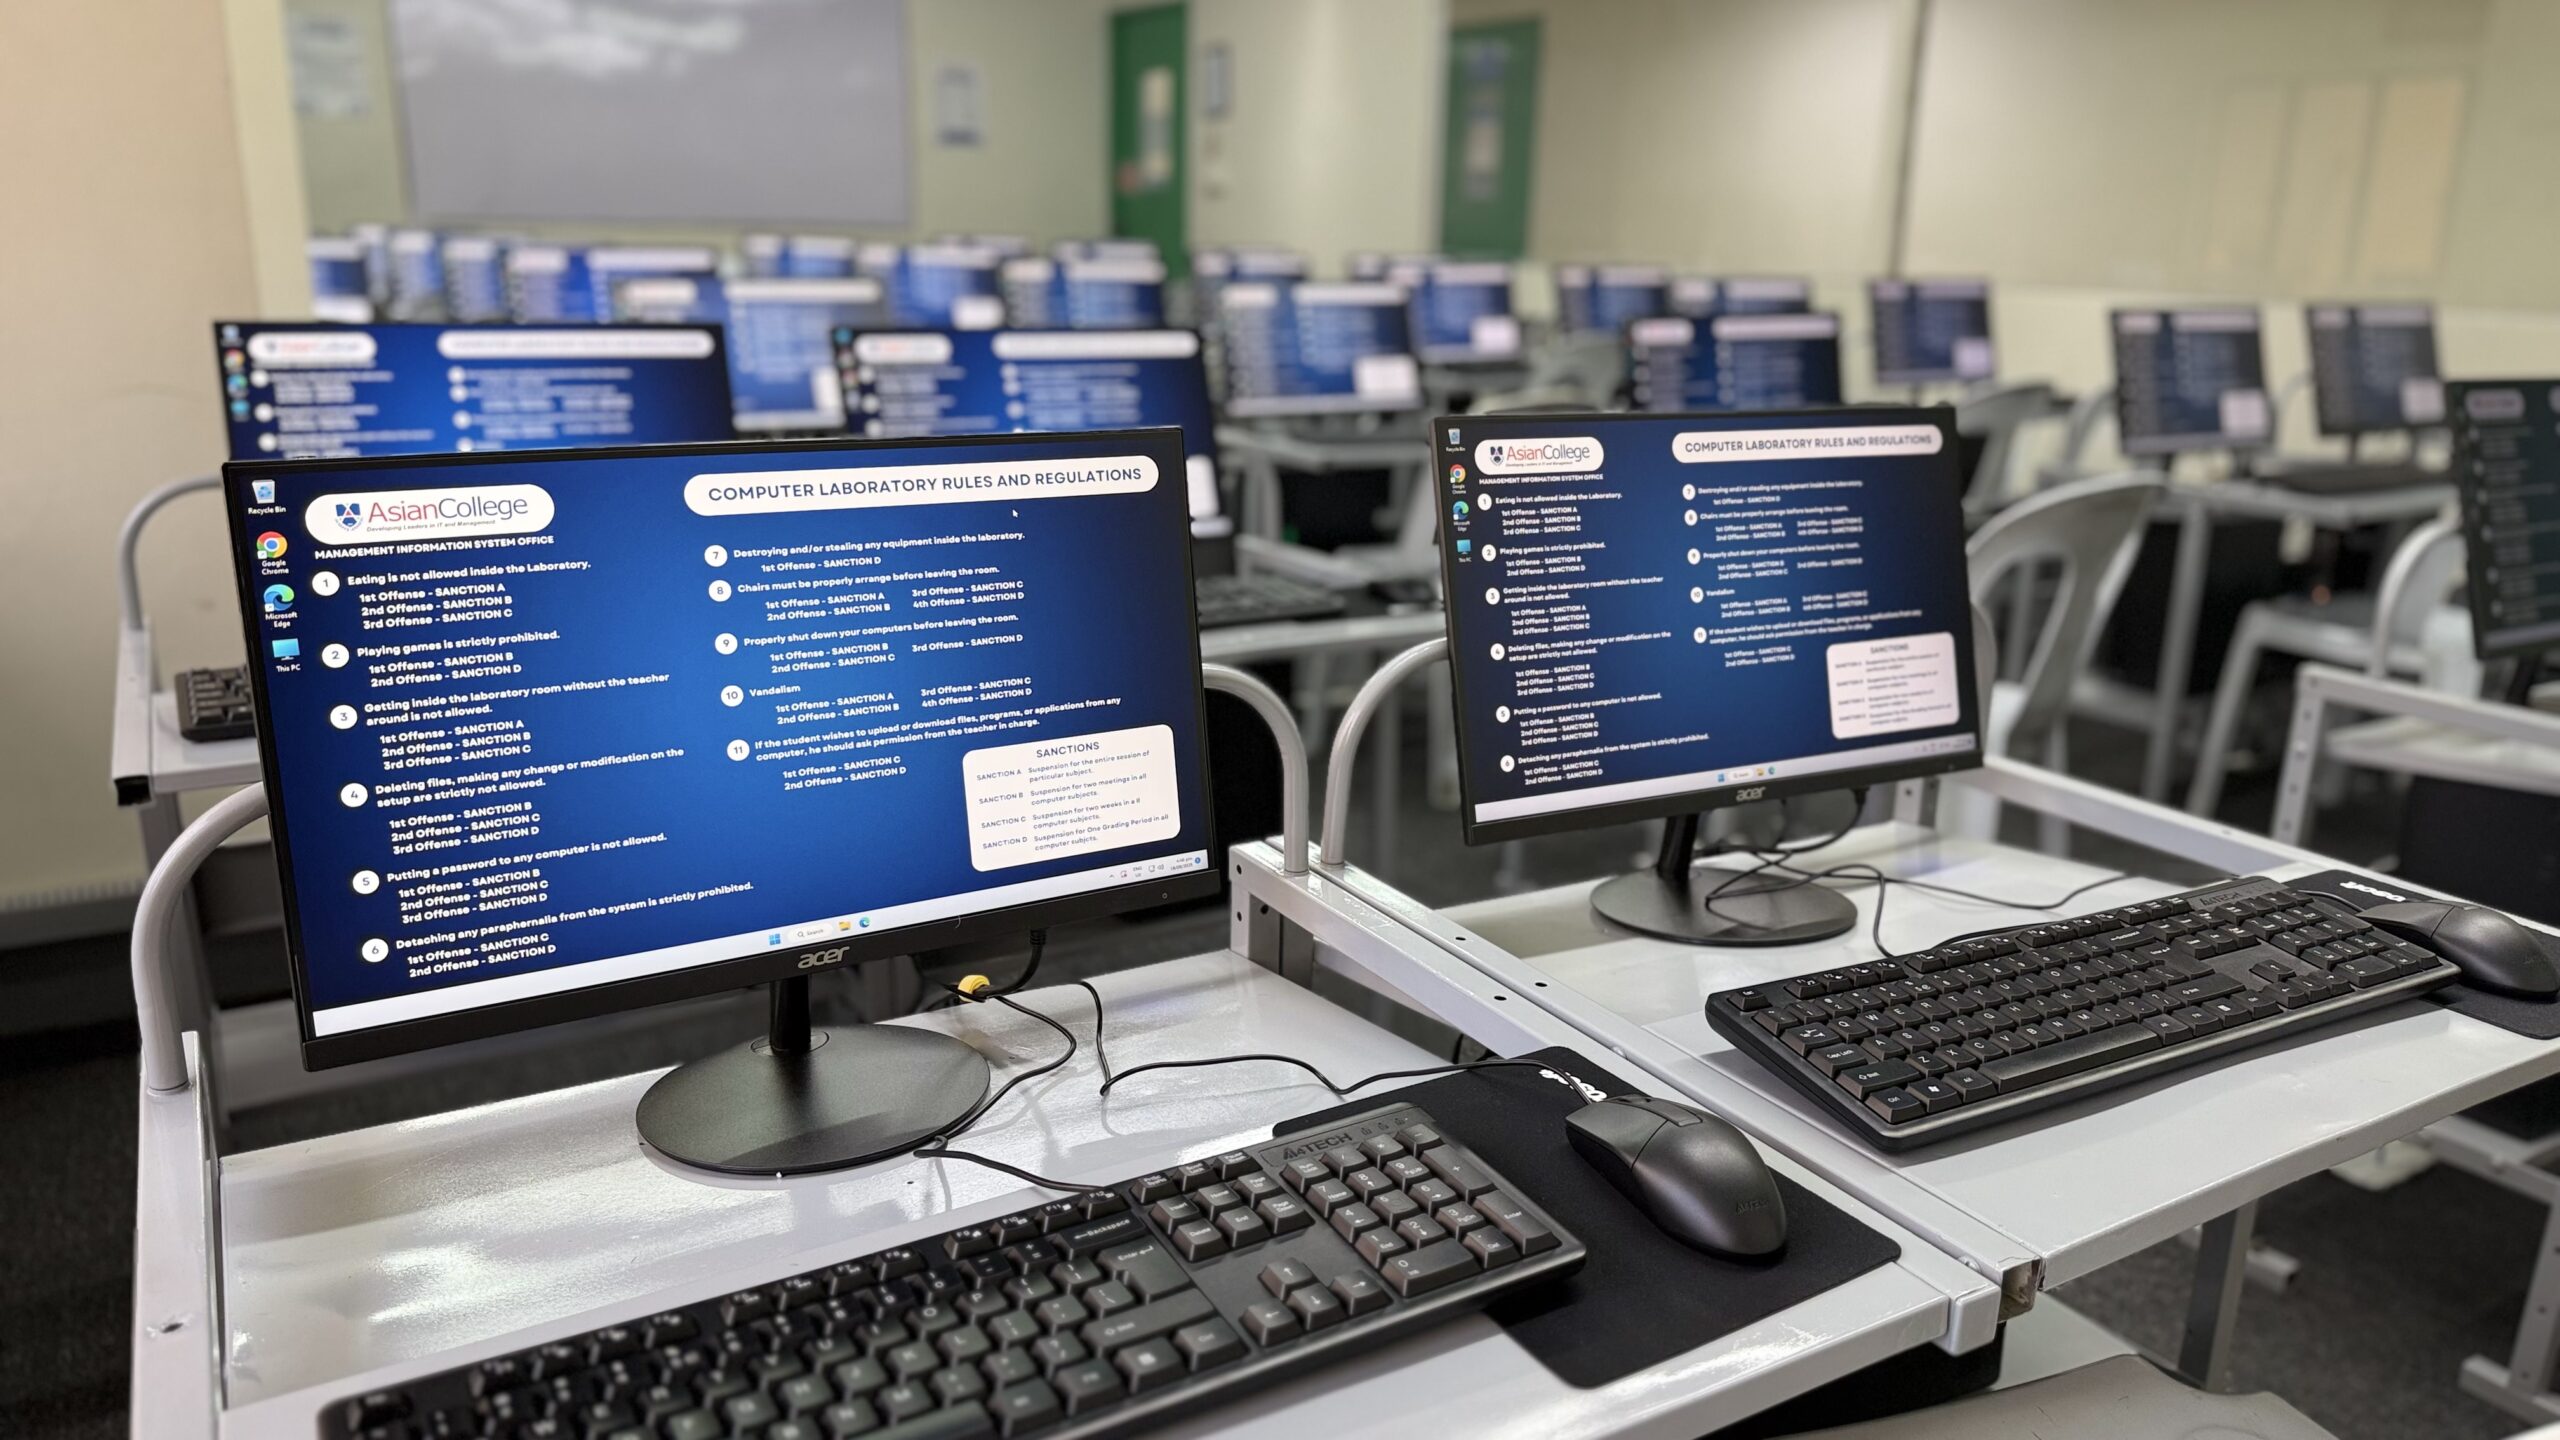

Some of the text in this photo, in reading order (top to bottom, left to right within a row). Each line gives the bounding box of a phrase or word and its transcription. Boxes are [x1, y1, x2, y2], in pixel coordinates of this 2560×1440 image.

[1685, 434, 1931, 452] COMPUTER LABORATORY RULES AND REGULATIONS
[1507, 444, 1590, 462] AsianCollege
[708, 468, 1141, 500] COMPUTER LABORATORY RULES AND REGULATIONS
[248, 507, 274, 515] Recycle
[368, 496, 528, 523] AsianCollege
[314, 535, 554, 559] MANAGEMENT INFORMATION SYSTEM OFFICE
[713, 532, 1025, 559] 7 Destroying and/or stealing any equipment inside the laboratory.
[261, 560, 286, 568] Google
[323, 561, 591, 587] 1 Eating is not allowed inside the Laboratory.
[717, 566, 999, 595] 8 Chairs must be properly arrange before leaving the room.
[359, 593, 376, 602] 1st
[378, 590, 425, 601] Offense
[434, 583, 494, 596] SANCTION
[496, 583, 505, 591] A
[265, 611, 297, 620] Microsoft
[273, 620, 291, 629] Edge
[332, 630, 560, 660] 2 Playing games is strictly prohibited.
[276, 664, 290, 672] This
[340, 674, 669, 721] 3 Getting inside the laboratory room without the teacher
[727, 684, 800, 699] 10 Vandalism
[366, 703, 492, 725] around is not allowed.
[1036, 741, 1099, 758] SANCTIONS
[375, 780, 425, 794] Deleting
[426, 777, 455, 787] files,
[456, 771, 499, 783] making
[501, 769, 521, 778] any
[523, 763, 564, 775] change
[580, 752, 649, 768] modification
[650, 751, 664, 759] on
[665, 748, 684, 757] the
[1027, 763, 1068, 773] Suspension
[1116, 752, 1141, 760] session
[976, 770, 1014, 780] SANCTION
[1029, 768, 1093, 783] particular subject.
[376, 777, 545, 807] setup are strictly not allowed.
[1736, 786, 1766, 802] acer
[362, 877, 370, 886] 5
[386, 868, 430, 881] Putting
[432, 867, 439, 875] a
[441, 857, 496, 875] password
[513, 853, 533, 863] any
[534, 845, 589, 859] computer
[590, 842, 600, 851] is
[601, 839, 620, 849] not
[622, 832, 667, 846] allowed.
[372, 881, 753, 954] 6 Detaching any paraphernalia from the system is strictly prohibited.
[797, 946, 850, 969] acer
[1283, 1133, 1353, 1160] A4TECH
[1358, 1173, 1369, 1181] 8
[1318, 1185, 1327, 1193] 7
[1448, 1208, 1459, 1216] 3
[1087, 1219, 1130, 1236] Backspace
[1409, 1221, 1420, 1229] 2
